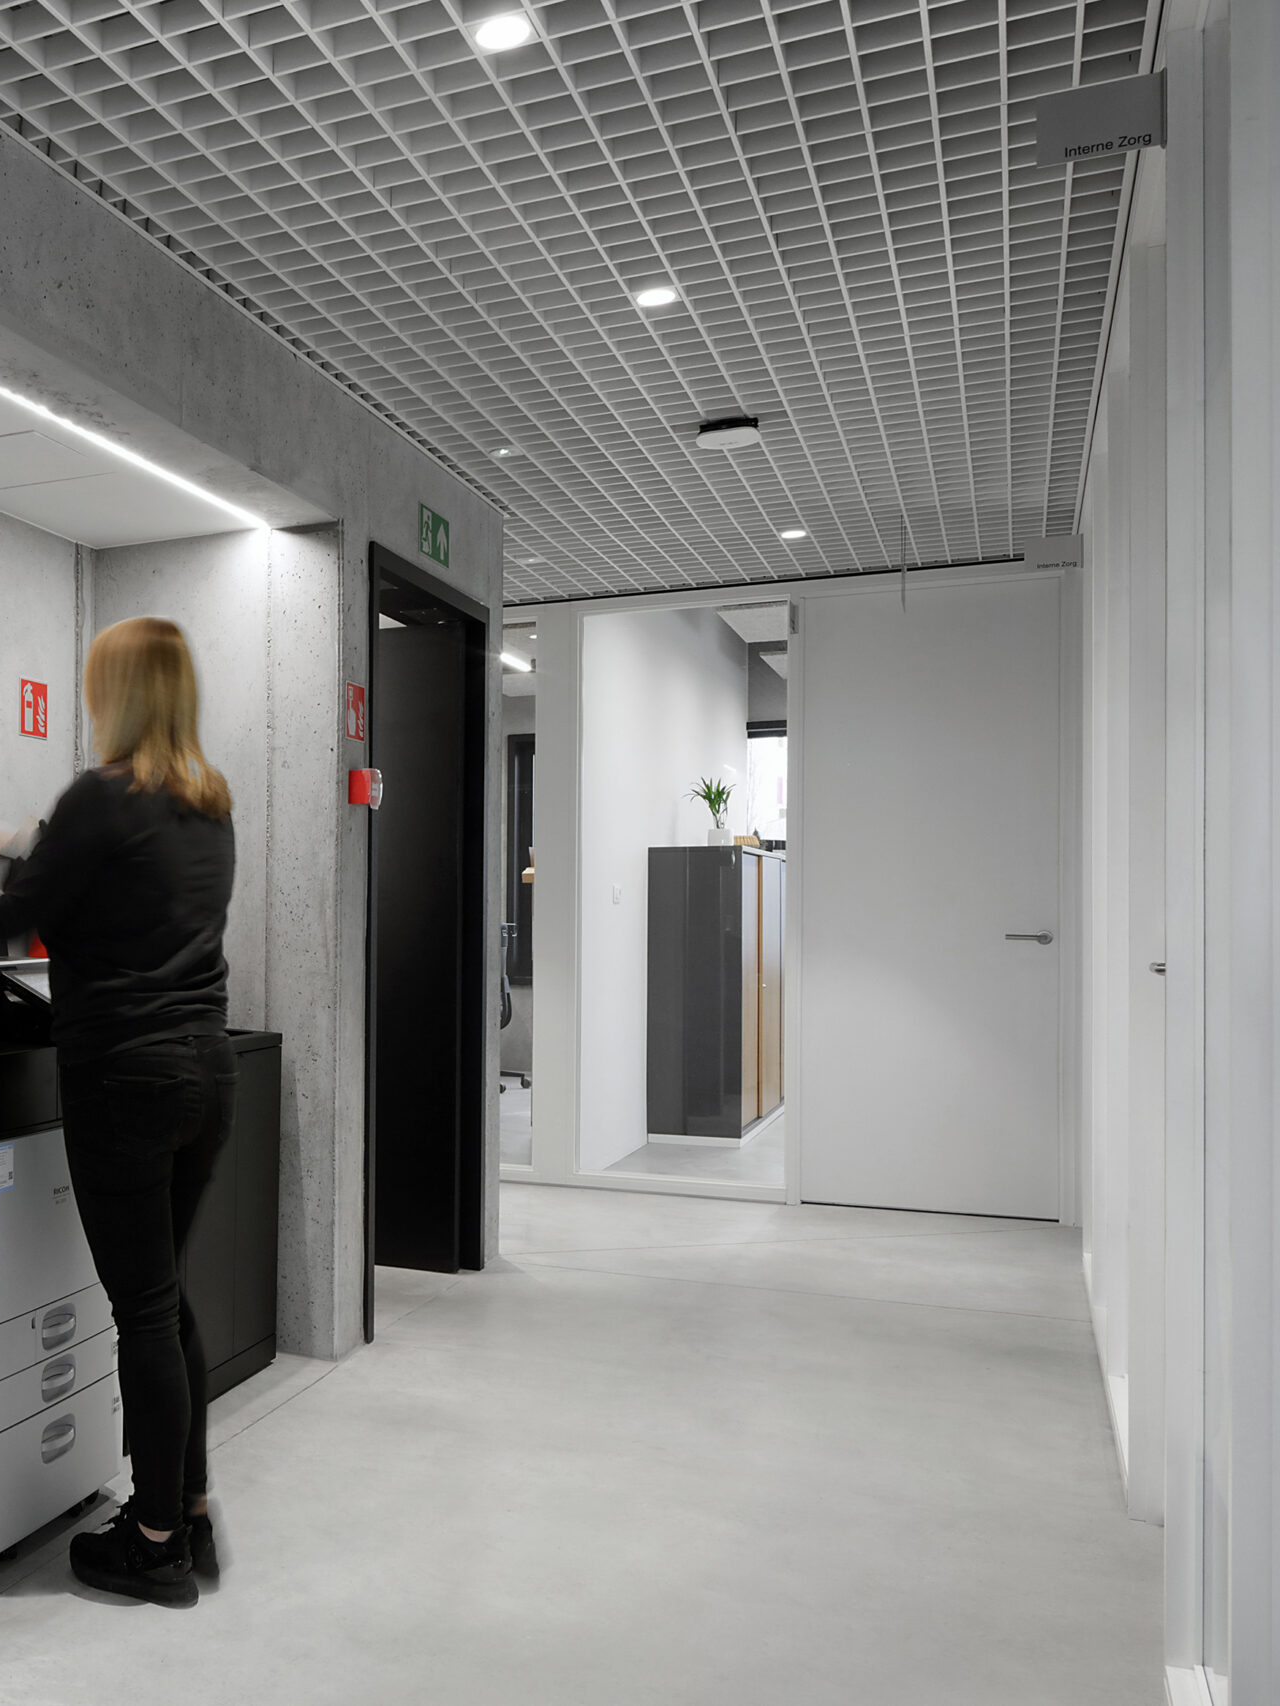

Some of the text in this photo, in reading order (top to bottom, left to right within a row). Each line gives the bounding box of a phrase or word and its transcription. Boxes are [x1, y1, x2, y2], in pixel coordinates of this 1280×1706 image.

[1064, 133, 1152, 158] Interne Zorg
[1061, 560, 1077, 568] Zorg
